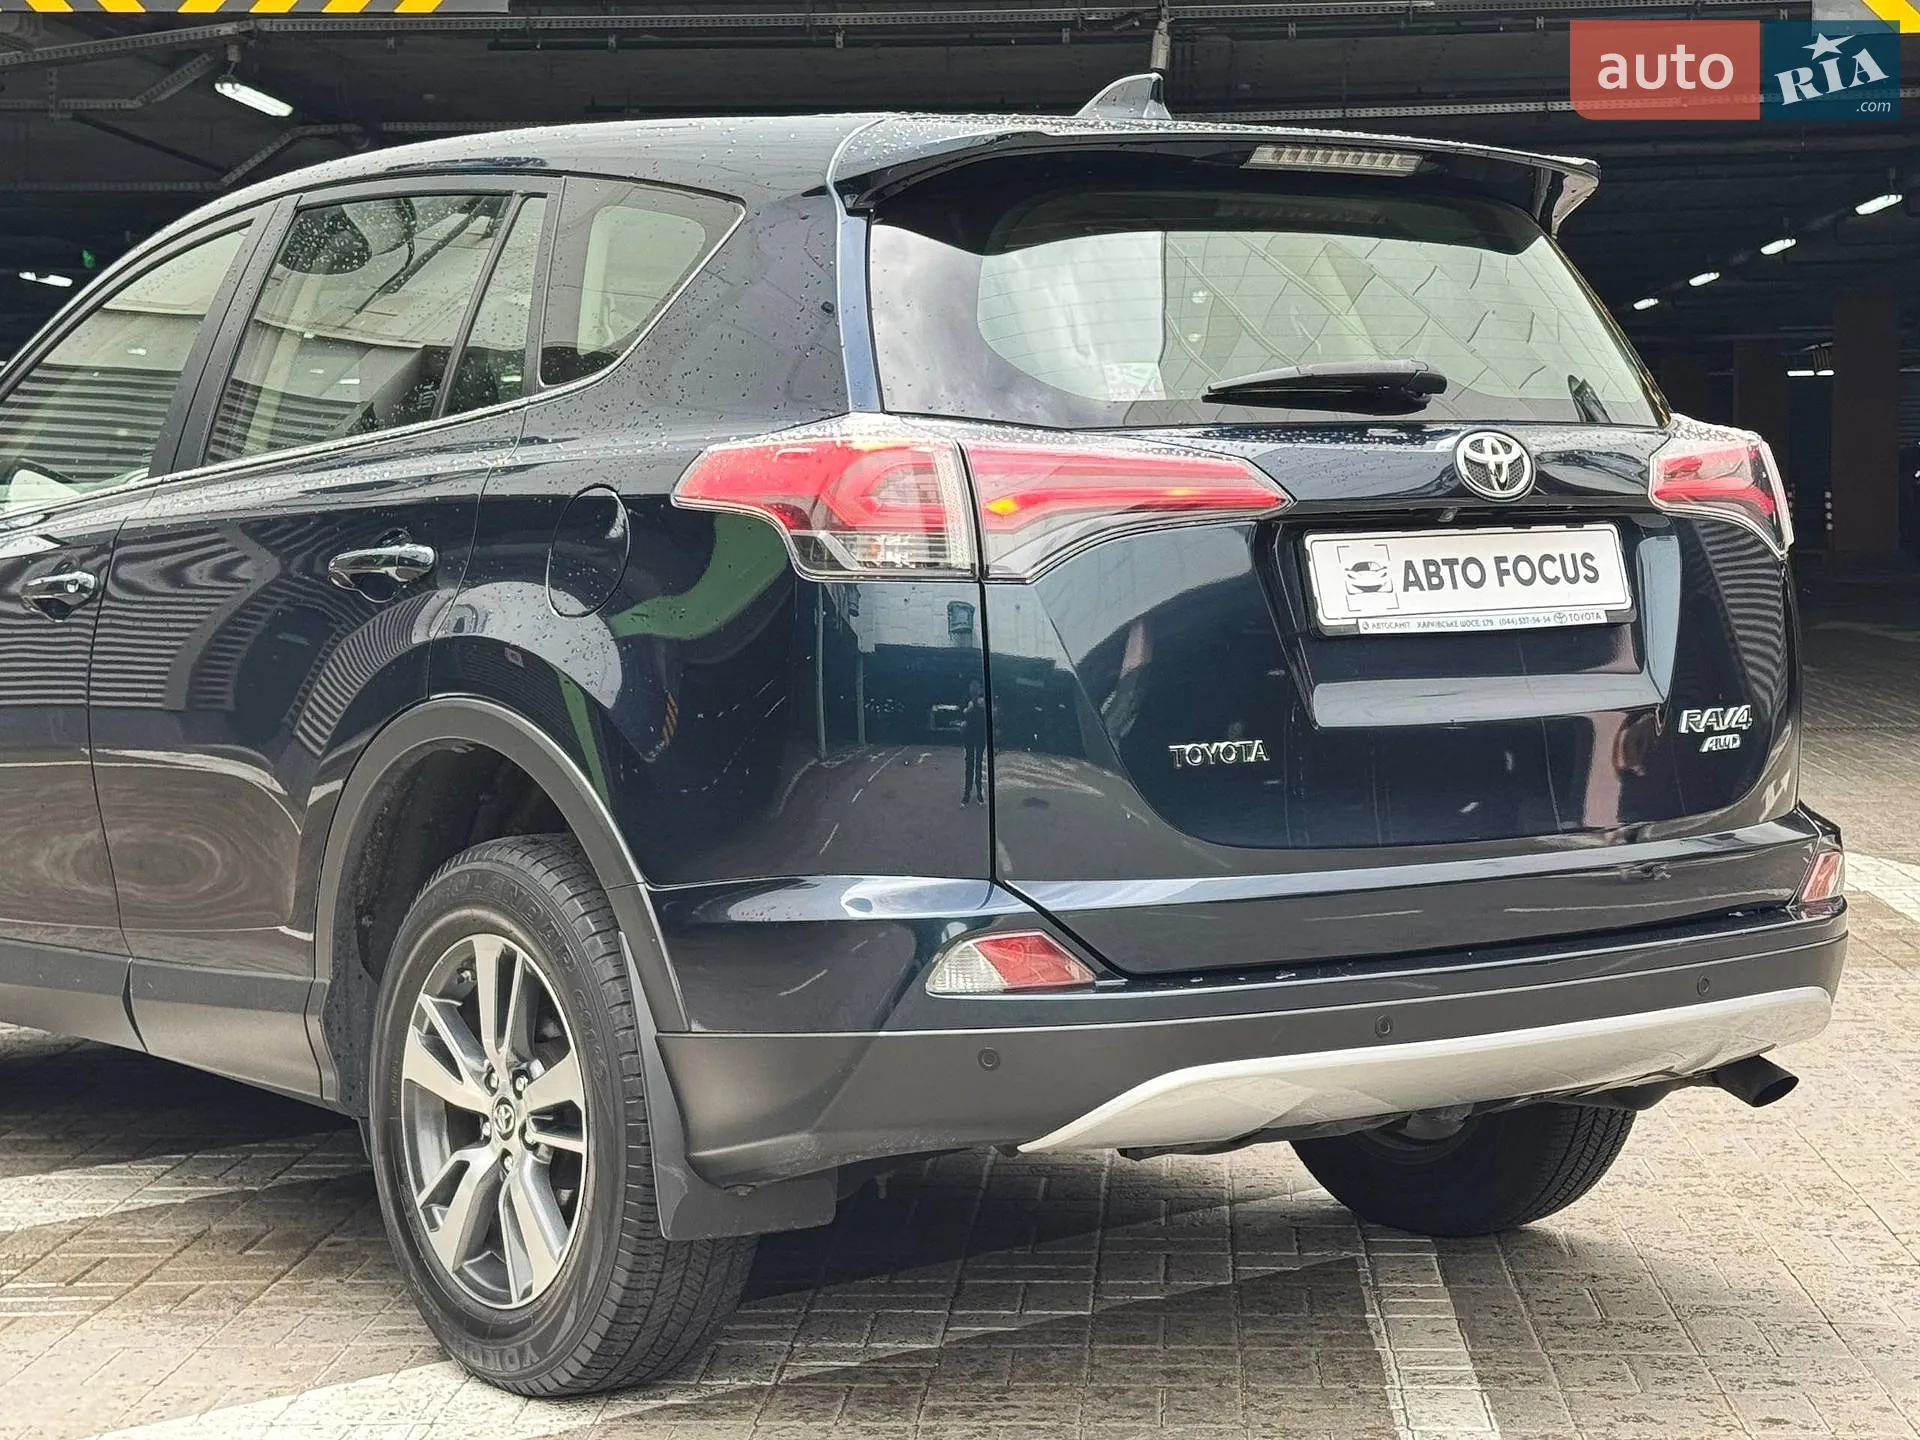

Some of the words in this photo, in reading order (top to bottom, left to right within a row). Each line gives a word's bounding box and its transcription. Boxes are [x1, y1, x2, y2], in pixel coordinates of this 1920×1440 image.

[1402, 557, 1487, 592] АВТО
[1495, 552, 1600, 587] FOCUS
[1568, 612, 1602, 622] TOYOTA
[1678, 704, 1752, 733] RAV4
[1168, 739, 1270, 768] TOYOTA
[1699, 734, 1741, 753] AWD
